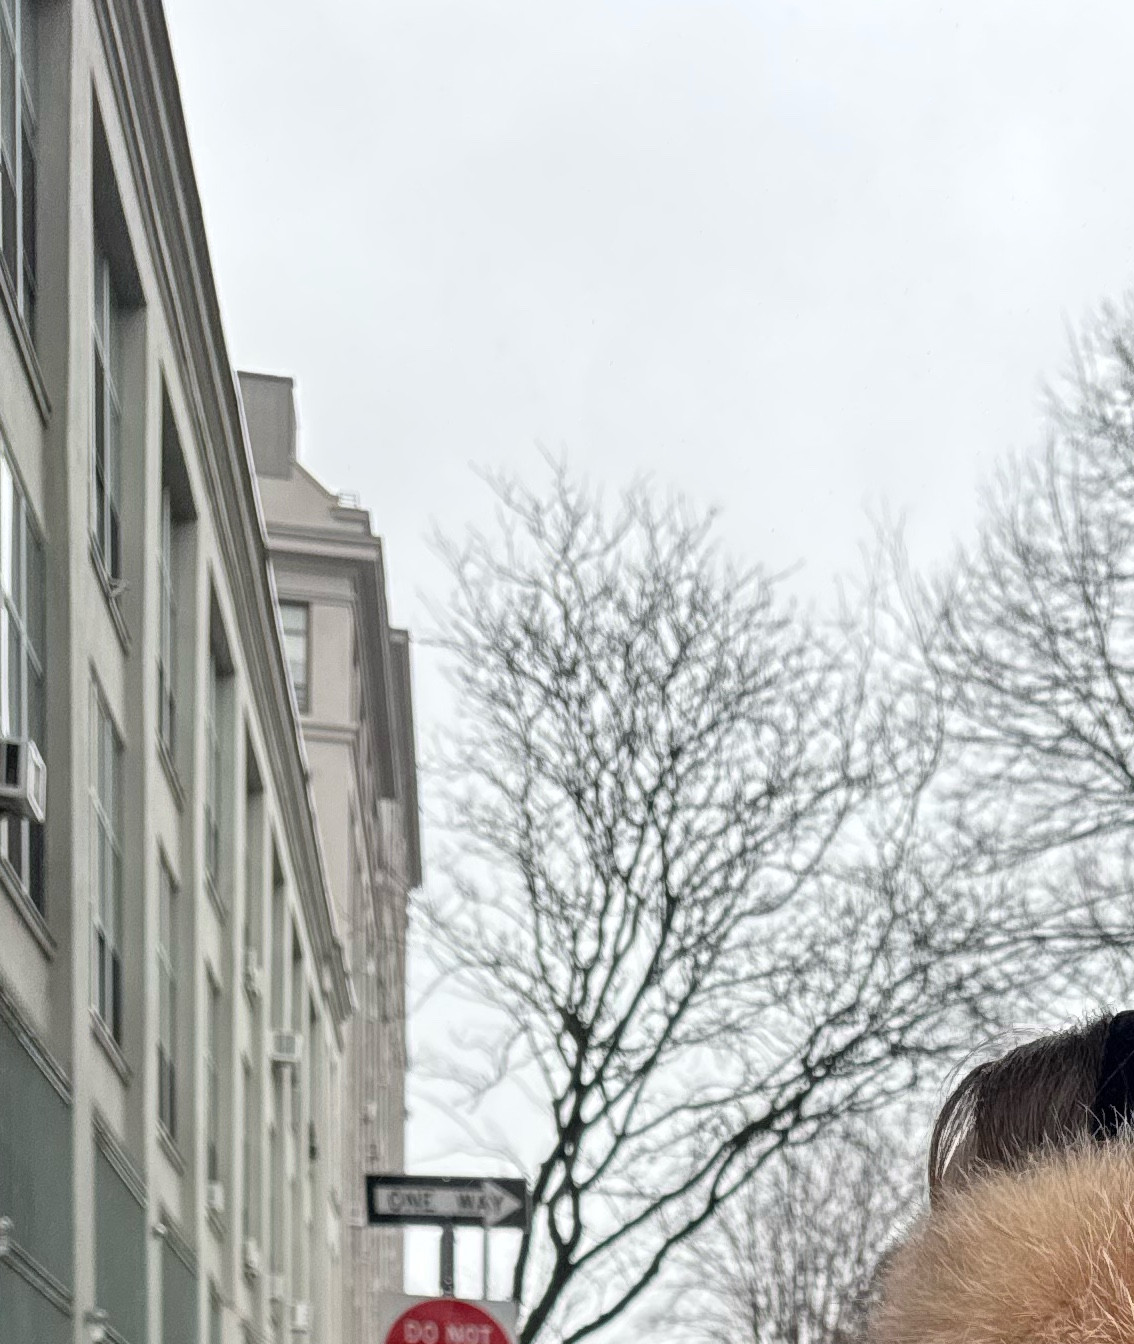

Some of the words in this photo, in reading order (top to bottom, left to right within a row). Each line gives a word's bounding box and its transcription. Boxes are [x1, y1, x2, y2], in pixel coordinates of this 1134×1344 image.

[387, 1189, 436, 1214] ONE
[457, 1191, 505, 1213] WAY
[404, 1320, 438, 1344] DO
